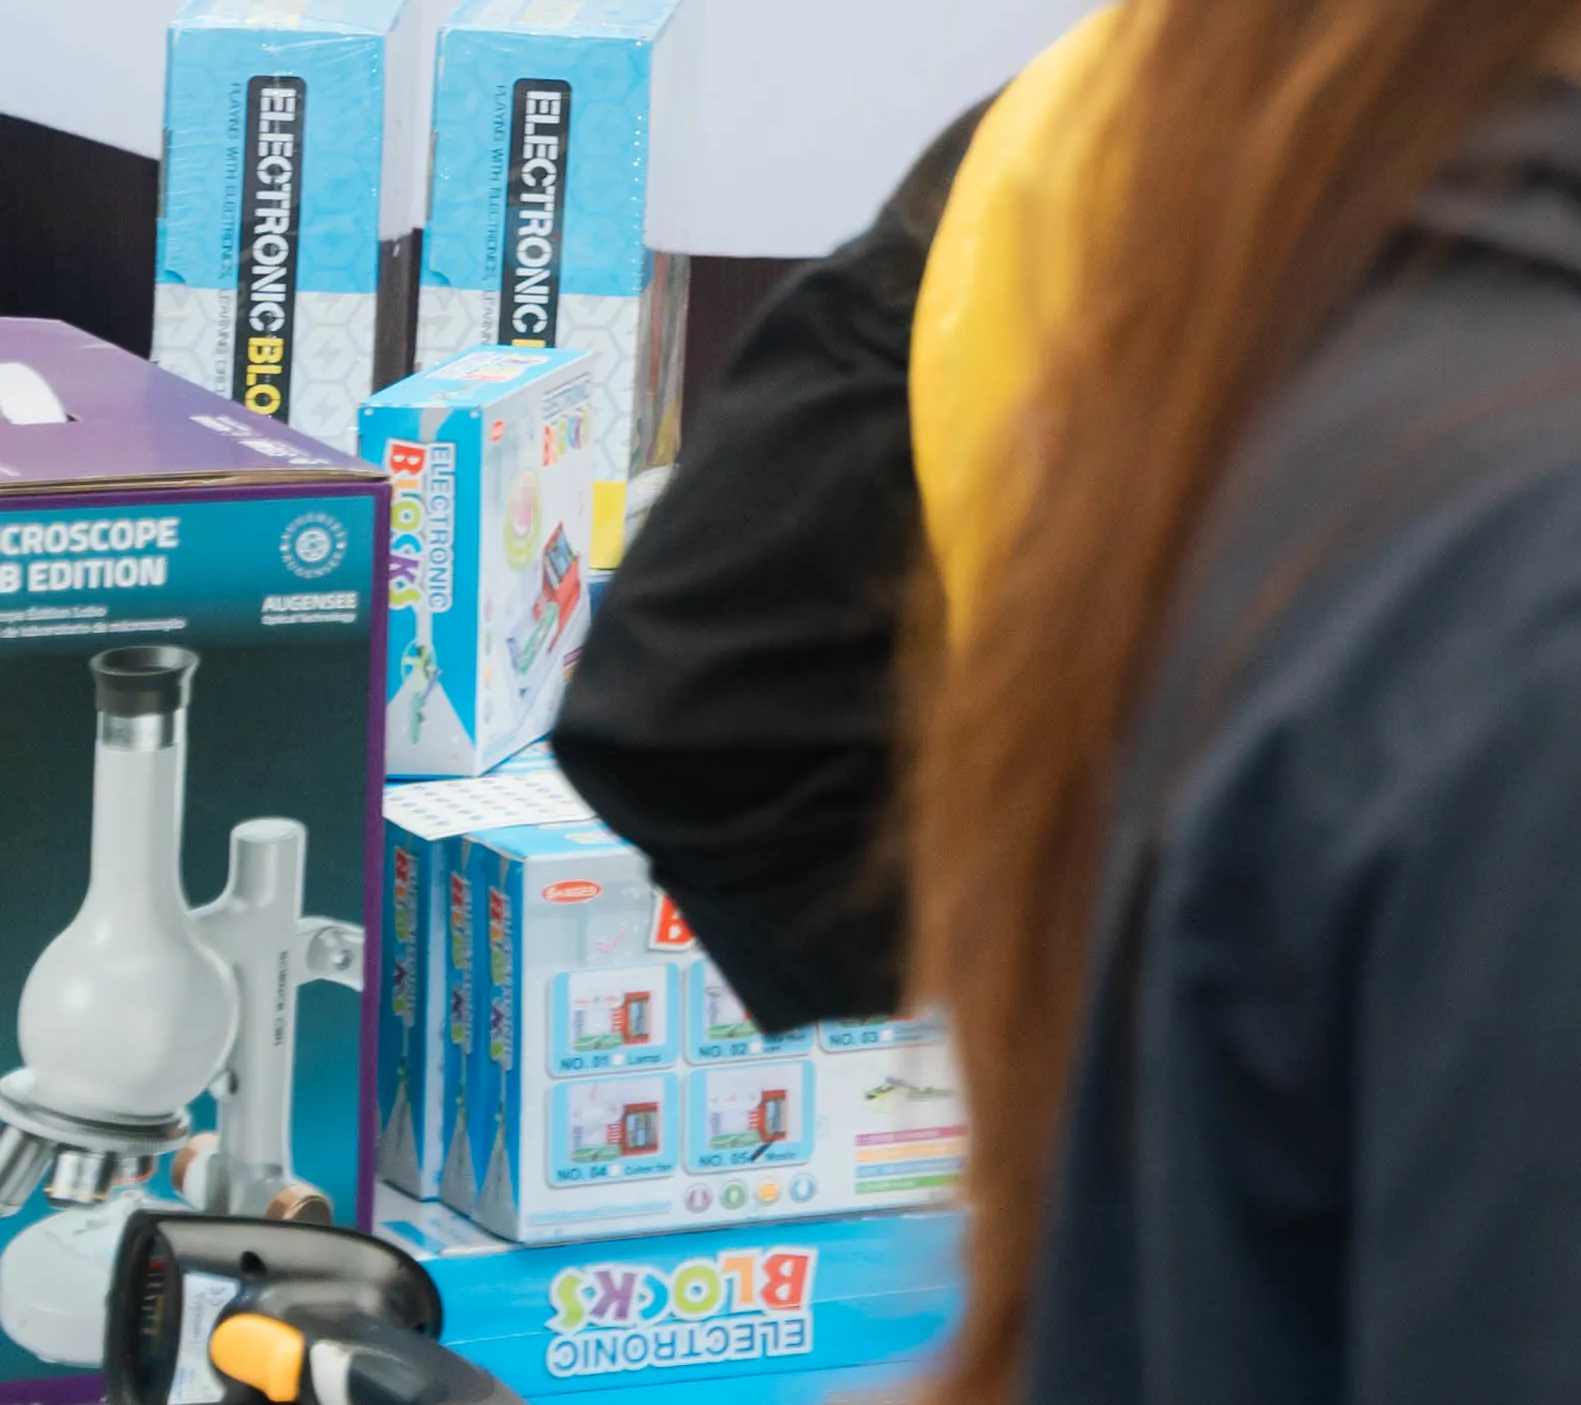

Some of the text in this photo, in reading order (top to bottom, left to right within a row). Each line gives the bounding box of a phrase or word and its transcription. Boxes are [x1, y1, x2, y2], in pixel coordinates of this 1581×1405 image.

[249, 87, 297, 333] ELECTRONIC
[512, 90, 562, 334] ELECTRONIC
[429, 445, 452, 609] ELECTRONIC
[28, 555, 167, 593] EDITION
[260, 590, 358, 613] AUGENSEE
[556, 1253, 810, 1328] BLOCKS
[554, 1318, 805, 1371] ELECTRONIC
